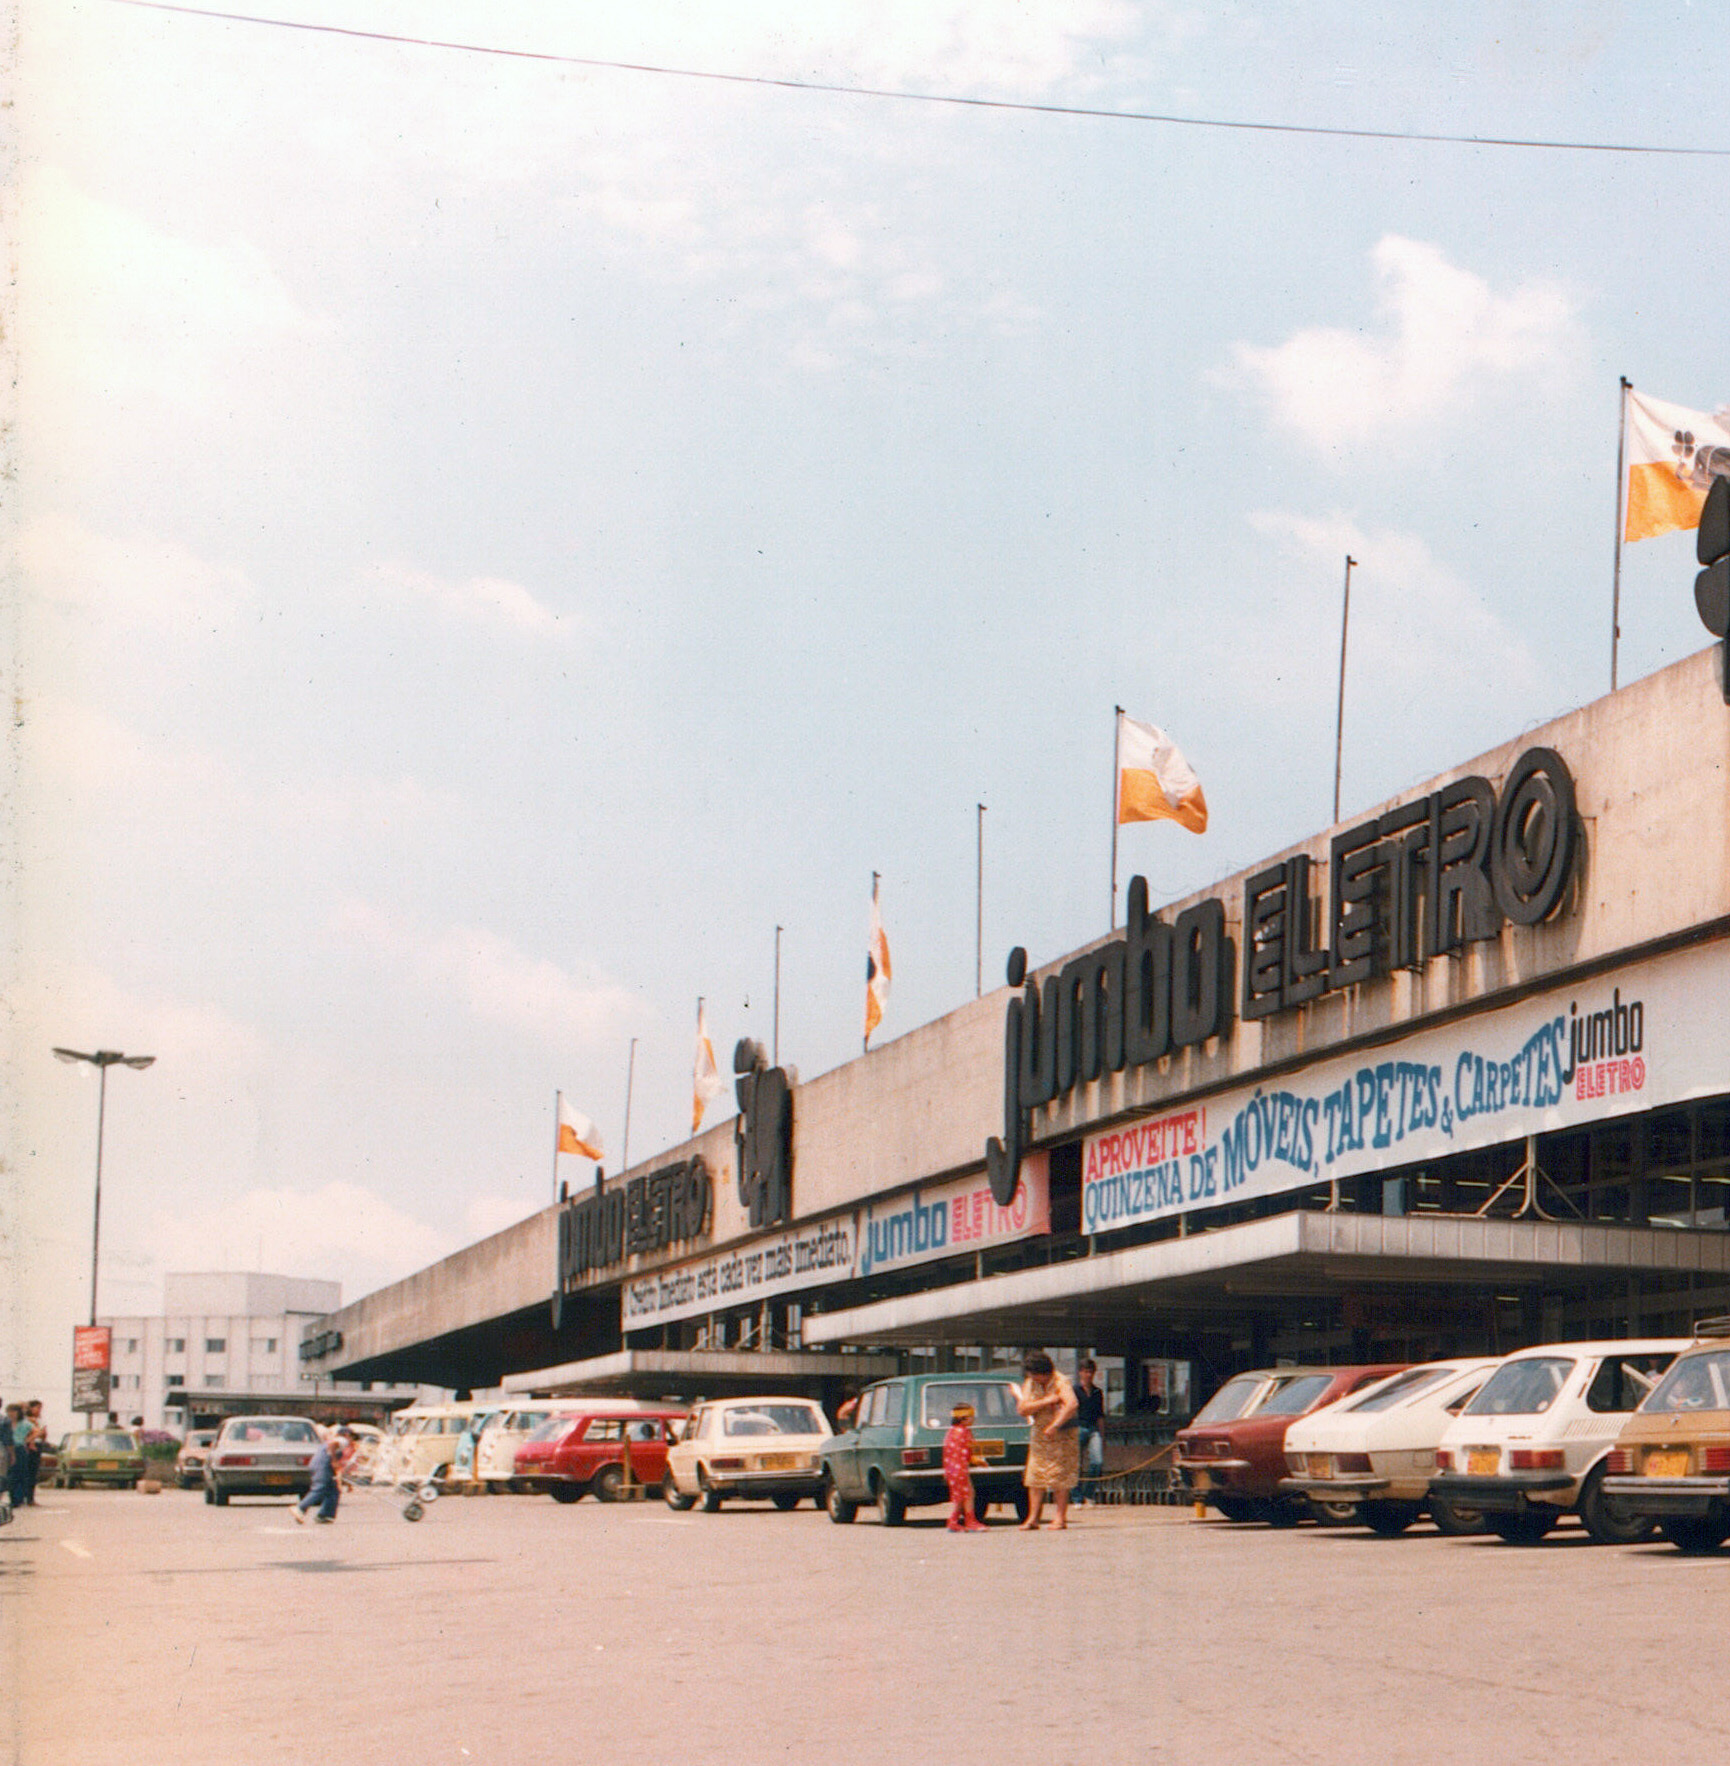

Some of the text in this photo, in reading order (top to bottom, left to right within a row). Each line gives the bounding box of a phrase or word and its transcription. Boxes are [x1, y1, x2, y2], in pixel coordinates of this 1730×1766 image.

[986, 747, 1578, 1206] jumbo ELETRO
[1563, 987, 1643, 1085] jumbo
[1576, 1056, 1645, 1101] ELETRO
[1085, 1016, 1565, 1232] QUINZENA DE MÓVEIS, TAPETES & CARPETES
[552, 1153, 708, 1331] jumbo ELETRO
[720, 1251, 743, 1293] cada
[745, 1253, 762, 1285] vez
[765, 1233, 792, 1280] mais
[861, 1188, 947, 1276] jumbo
